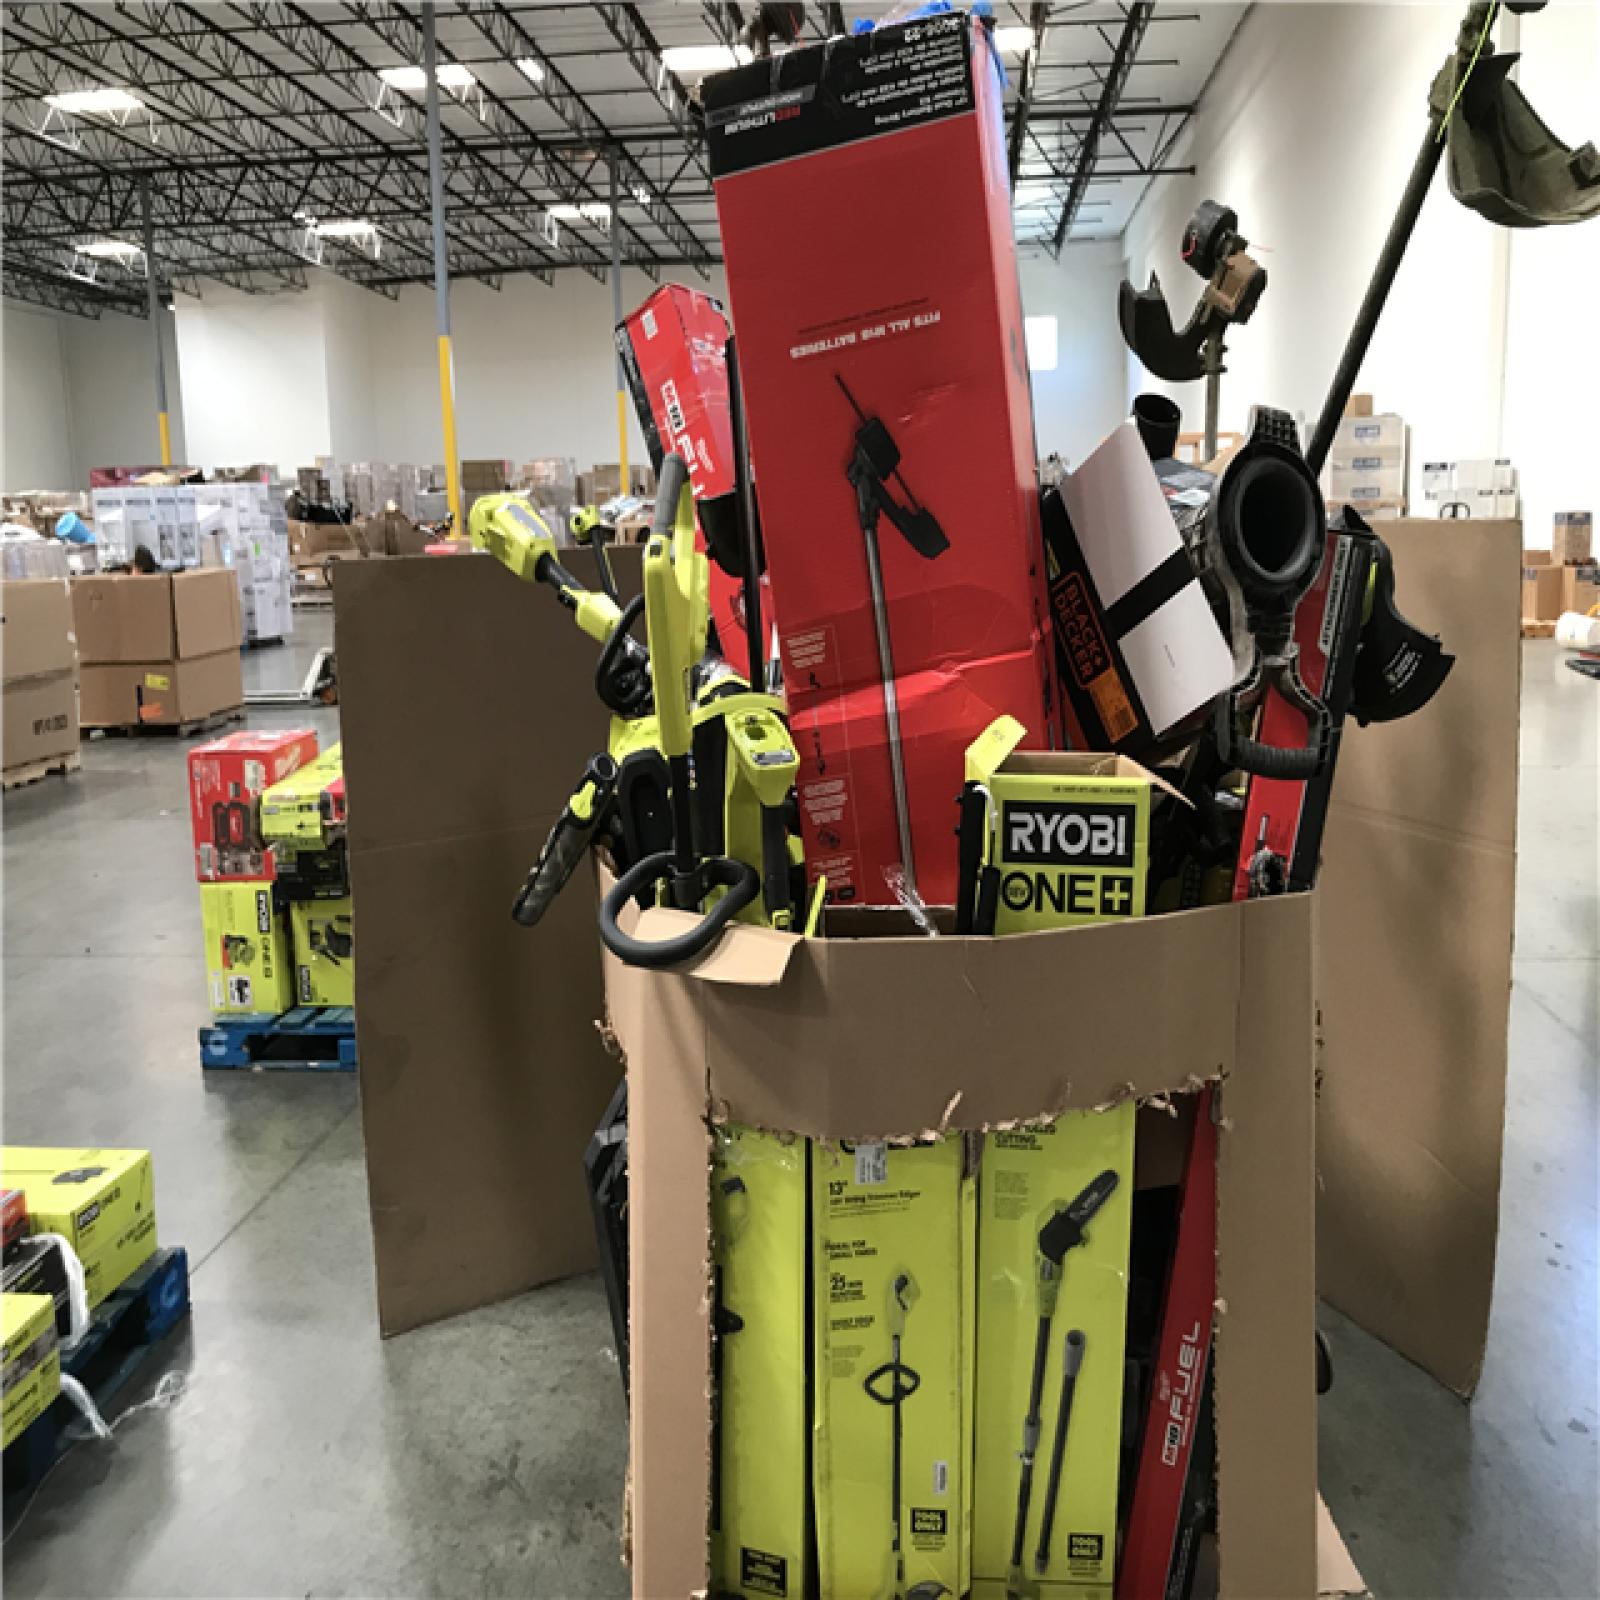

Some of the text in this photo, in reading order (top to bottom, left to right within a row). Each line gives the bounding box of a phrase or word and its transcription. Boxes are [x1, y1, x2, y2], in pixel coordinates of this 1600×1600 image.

[887, 319, 911, 333] ALL
[913, 310, 941, 328] FITS
[790, 331, 856, 359] BATTERIES
[1009, 811, 1128, 857] RYOBI
[1169, 1321, 1200, 1421] FUEL
